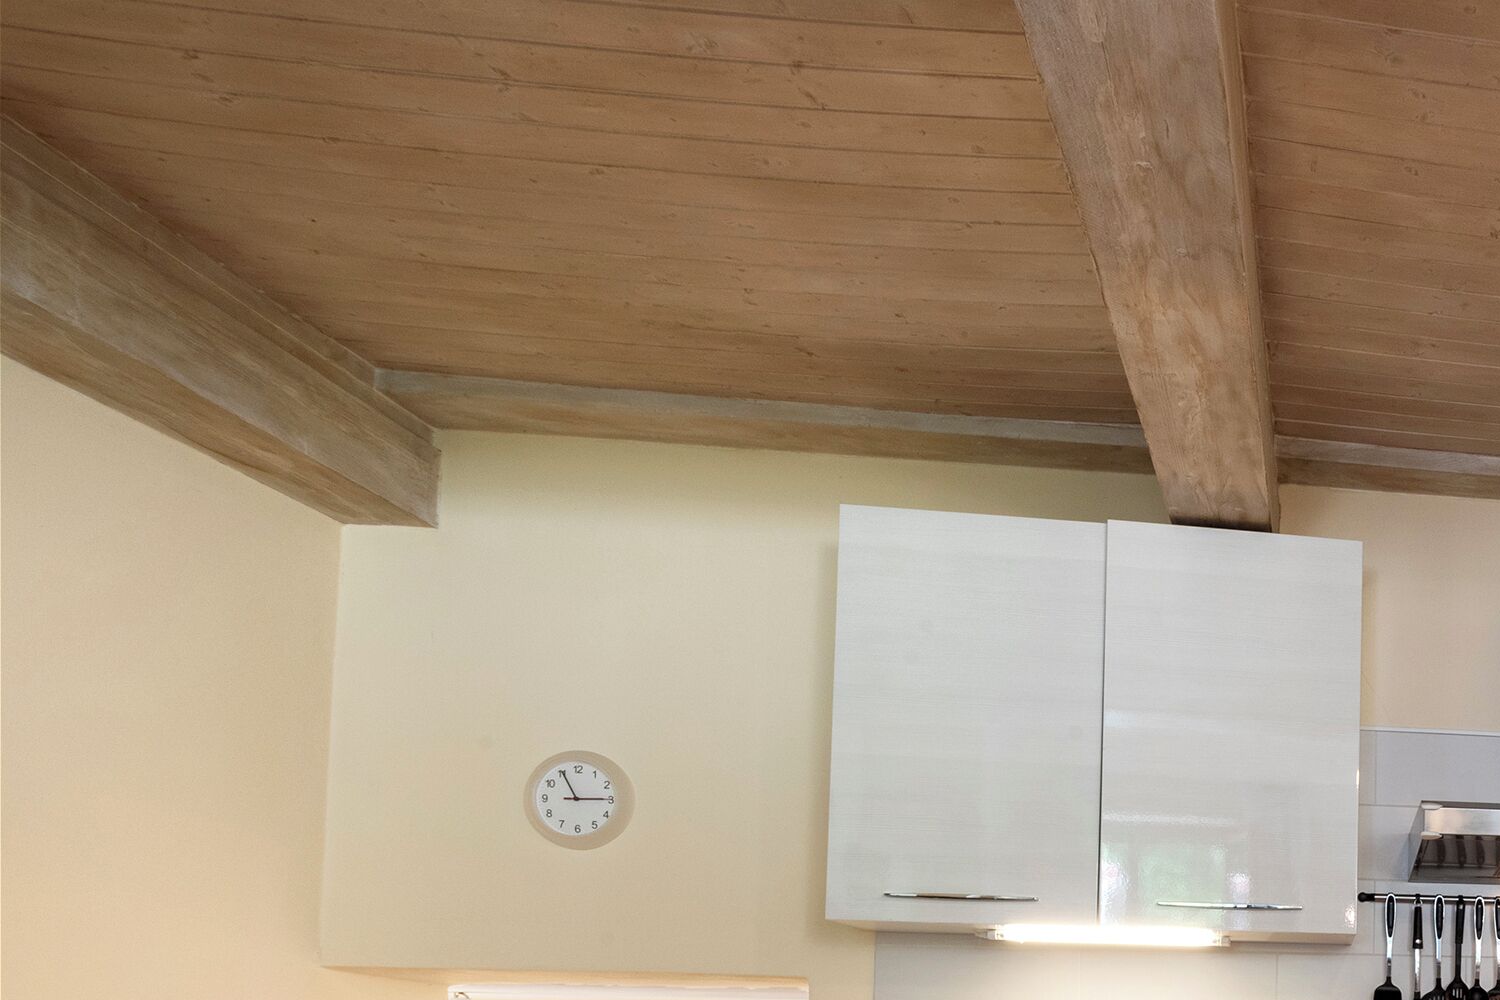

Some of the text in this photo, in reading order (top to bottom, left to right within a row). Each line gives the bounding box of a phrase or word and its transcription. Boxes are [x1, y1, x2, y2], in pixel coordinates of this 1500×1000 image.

[573, 765, 583, 774] 12
[592, 770, 597, 778] 1
[546, 779, 556, 788] 10
[604, 780, 610, 789] 2
[541, 794, 548, 803] 9
[608, 796, 614, 804] 3
[546, 809, 553, 818] 8
[603, 810, 609, 819] 4
[558, 820, 565, 828] 7
[574, 824, 581, 833] 6
[592, 820, 598, 829] 5
